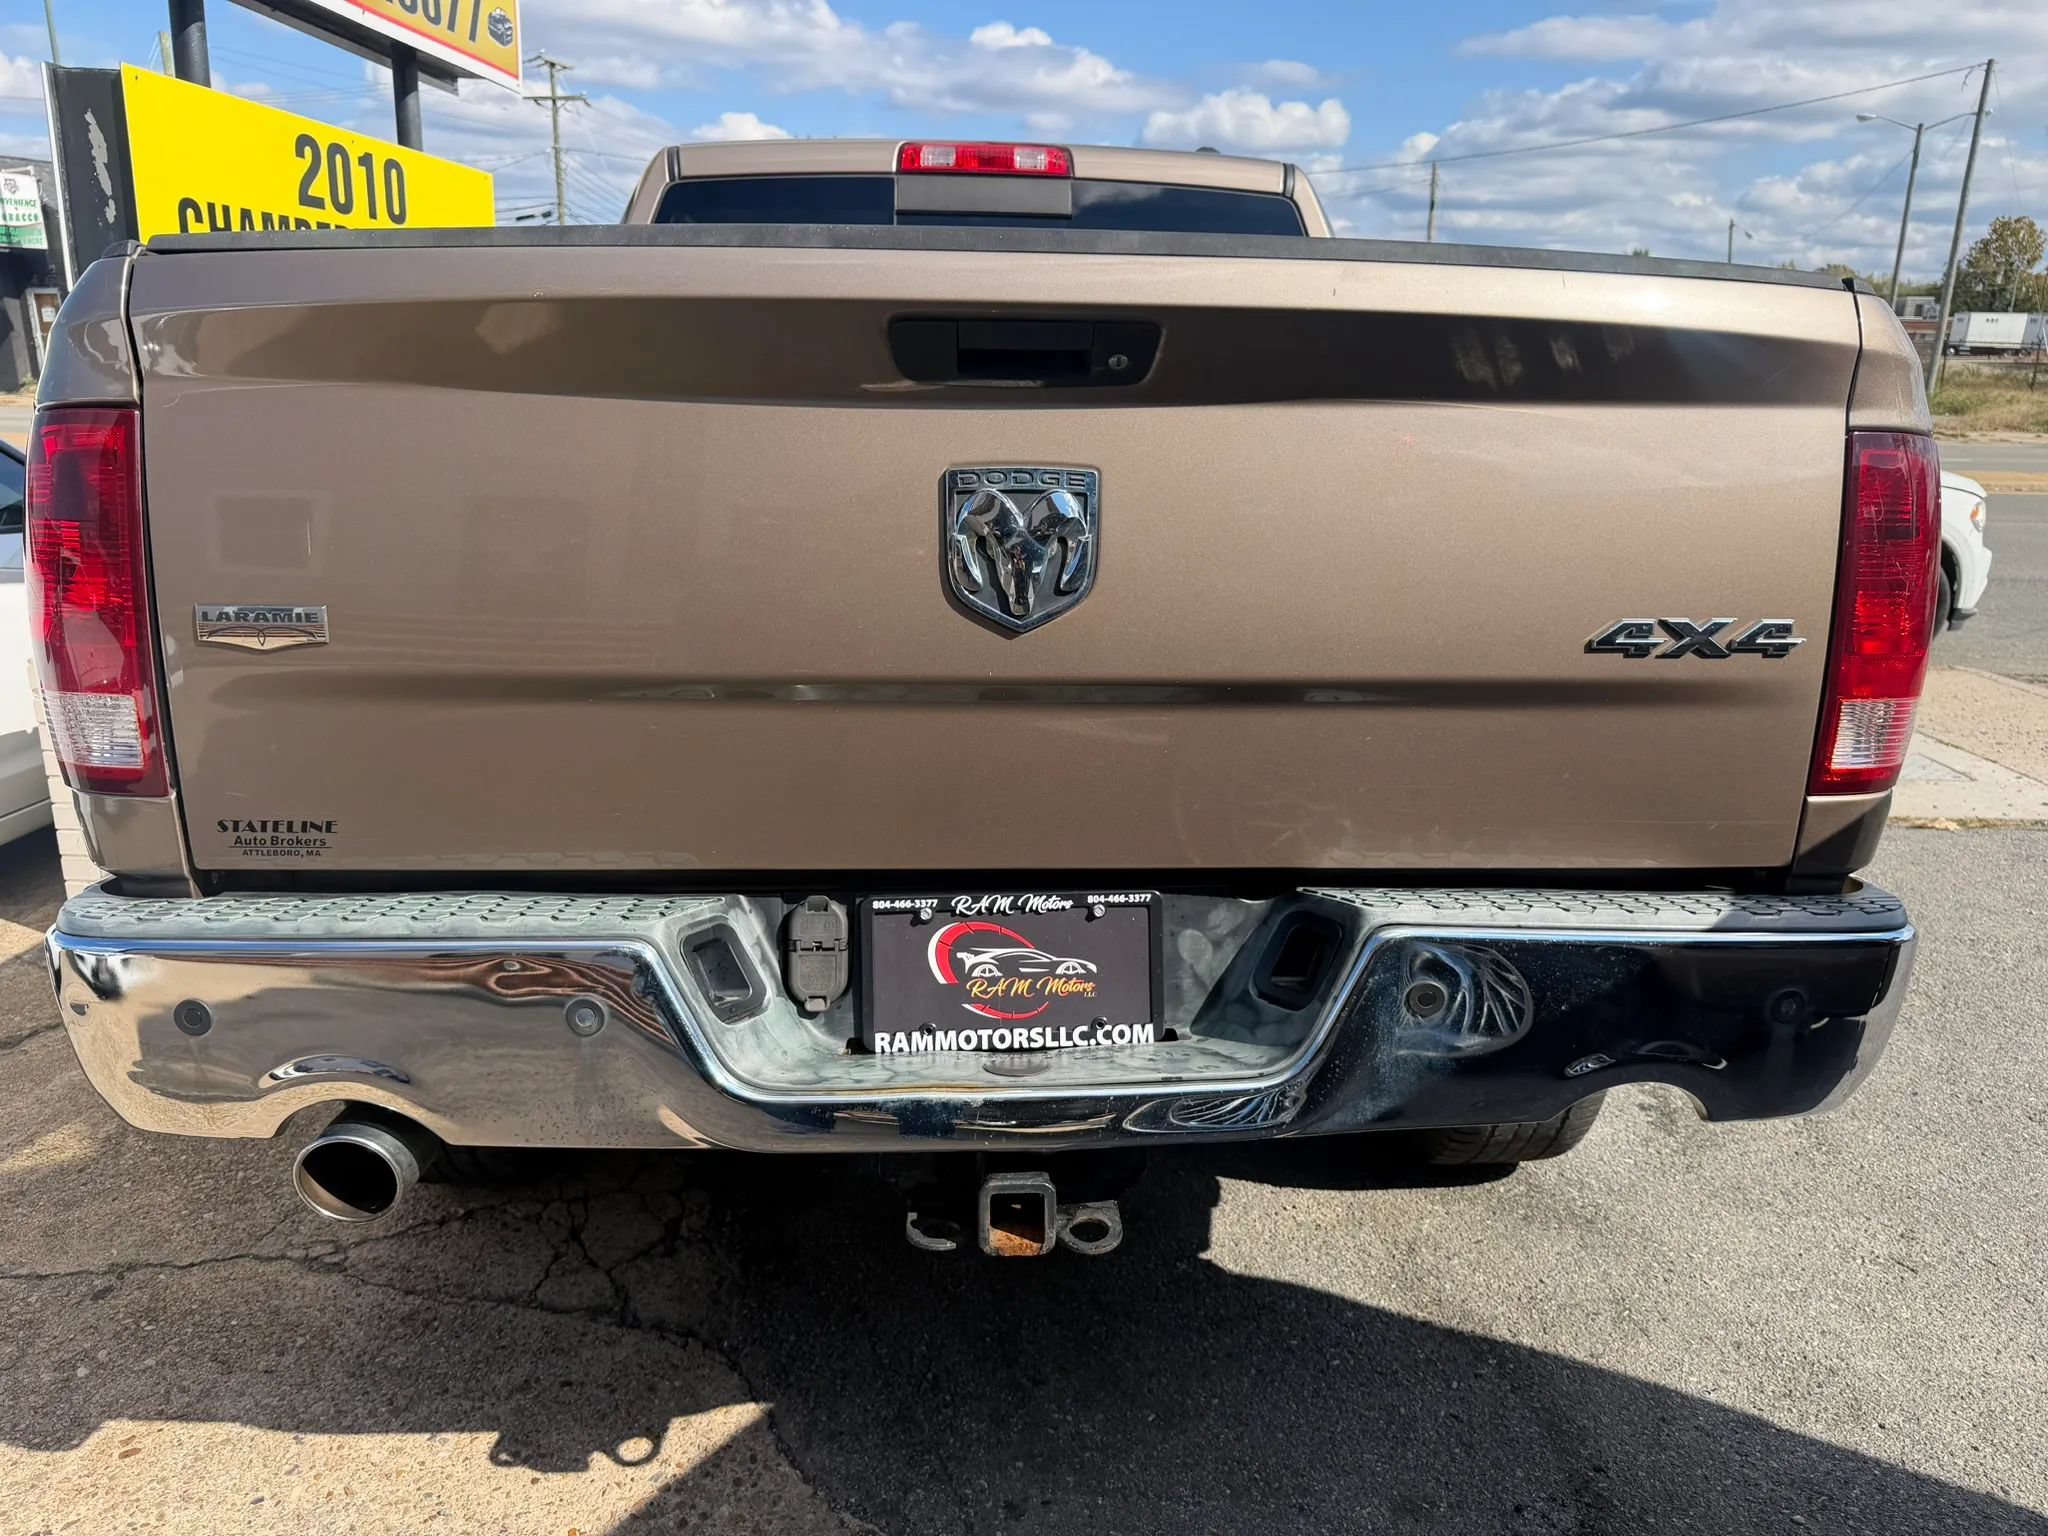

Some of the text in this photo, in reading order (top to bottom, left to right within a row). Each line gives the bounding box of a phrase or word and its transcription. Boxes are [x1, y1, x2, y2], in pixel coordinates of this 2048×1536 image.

[295, 133, 408, 226] 2010
[957, 472, 1086, 488] DODGE
[201, 611, 319, 624] LARAMIE
[216, 819, 339, 834] STATELINE
[233, 835, 327, 847] Auto Brokers
[242, 849, 321, 859] ATTLEBORO, MA
[872, 898, 938, 910] 804-466-3377
[951, 893, 1074, 915] RAM Motors
[1087, 893, 1152, 904] 804-466-3377
[966, 976, 1096, 999] RAM Motors
[874, 1023, 1155, 1055] RAMMOTORSLLC.COM
